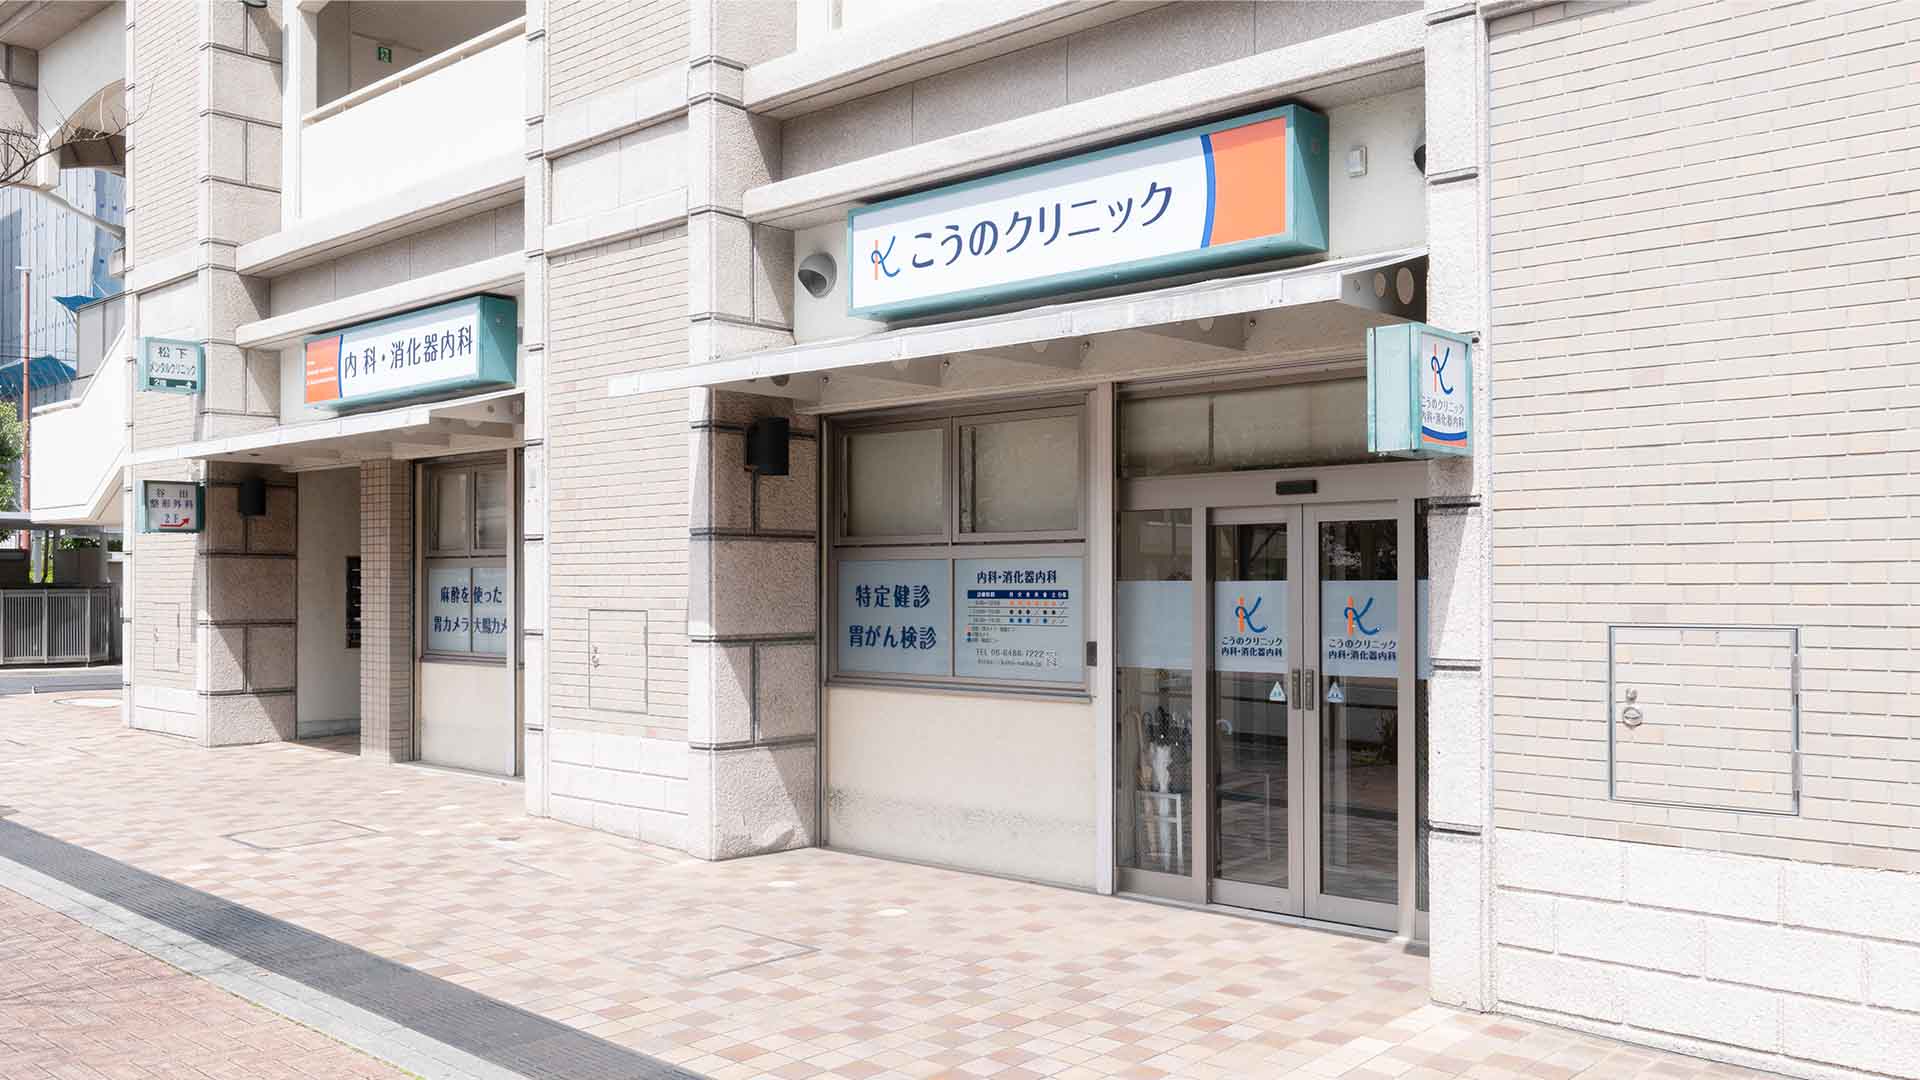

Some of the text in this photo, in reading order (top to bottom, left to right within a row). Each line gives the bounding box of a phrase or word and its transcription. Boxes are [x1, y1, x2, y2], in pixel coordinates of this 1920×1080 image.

[911, 180, 1173, 269] こうのクリニック
[976, 569, 1057, 584] 内科・消化器内科
[855, 584, 930, 608] 特定健診
[849, 624, 937, 649] 胃がん検診
[1222, 636, 1283, 646] こうのクリニック
[1328, 638, 1397, 649] こうのクリニック
[976, 648, 988, 656] TEL
[1221, 646, 1283, 657] 内科・消化器内科
[1328, 650, 1397, 661] 内科・消化器内科
